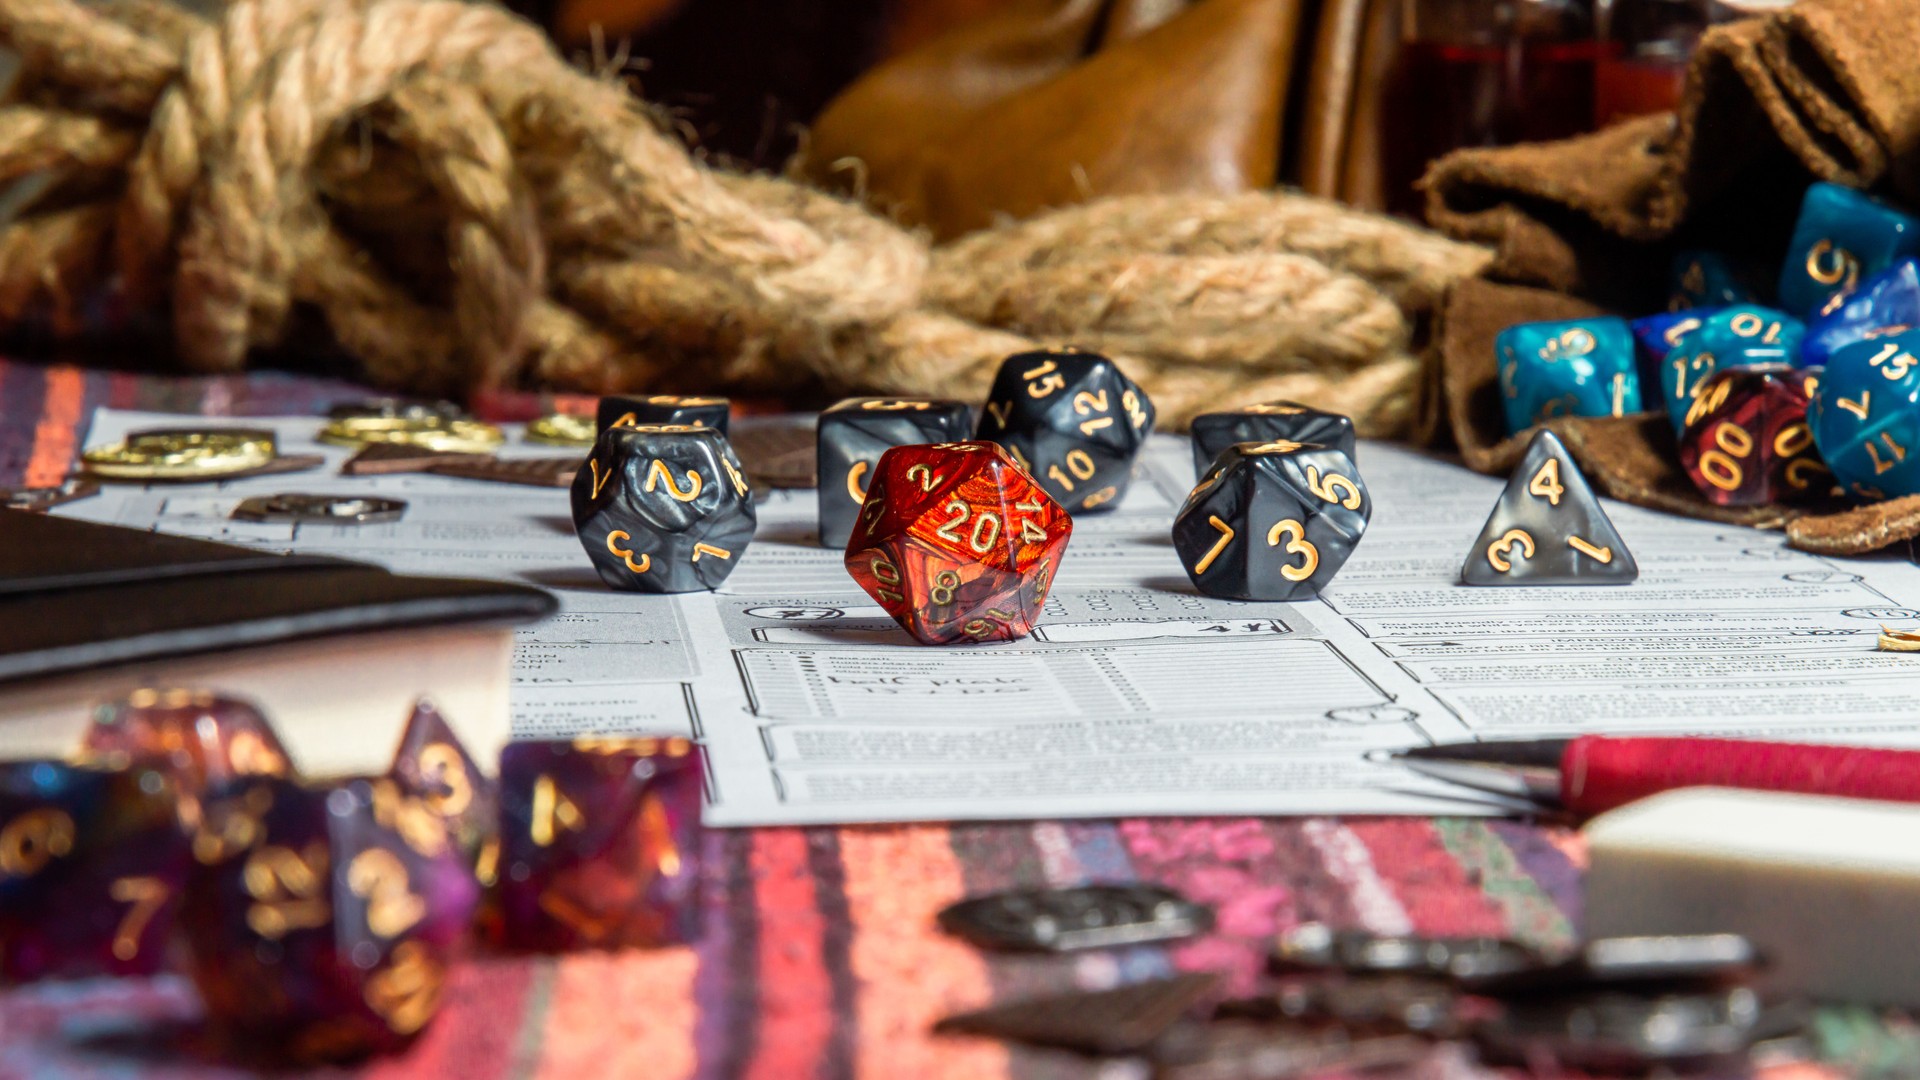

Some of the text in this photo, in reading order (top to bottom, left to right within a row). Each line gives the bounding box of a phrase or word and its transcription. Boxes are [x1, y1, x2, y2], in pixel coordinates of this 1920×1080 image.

[1023, 360, 1065, 398] 15
[1073, 389, 1113, 436] 12
[906, 463, 944, 493] 2
[1048, 449, 1095, 492] 10
[1699, 421, 1753, 491] 00
[645, 459, 703, 503] 2
[1307, 465, 1362, 511] 5
[1530, 458, 1564, 505] 4
[936, 499, 1002, 553] 20
[1015, 496, 1048, 545] 14
[606, 529, 651, 574] 3
[1194, 515, 1235, 576] 7
[1267, 518, 1320, 582] 3
[1487, 528, 1535, 572] 3
[1568, 534, 1612, 564] 1
[870, 557, 904, 604] 10
[931, 570, 961, 606] 8
[109, 875, 170, 962] 7
